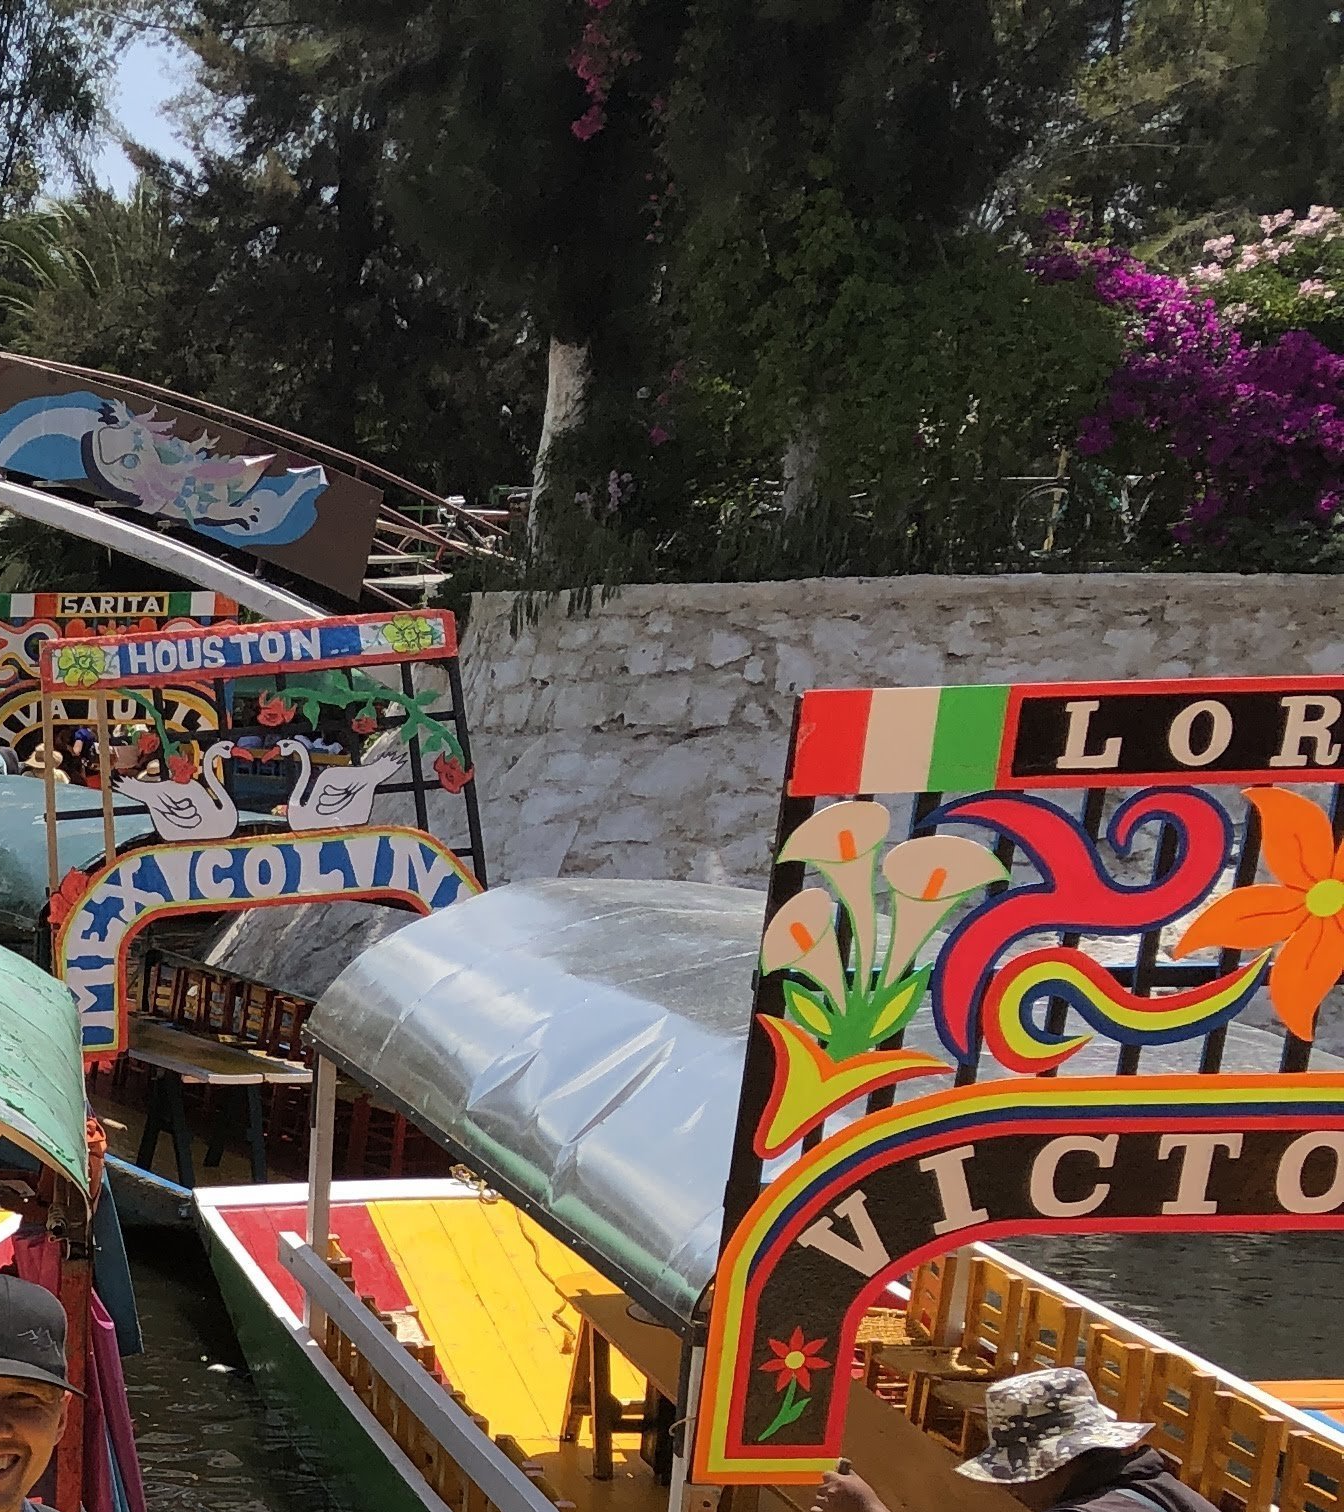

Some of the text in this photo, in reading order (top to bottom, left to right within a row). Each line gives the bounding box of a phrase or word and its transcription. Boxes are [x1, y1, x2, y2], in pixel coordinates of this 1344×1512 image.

[64, 597, 162, 614] SARITA
[128, 627, 322, 674] HOUSTON
[1056, 694, 1344, 770] LOR
[66, 836, 455, 1030] MEXICOLIN
[797, 1130, 1344, 1280] VICTO
